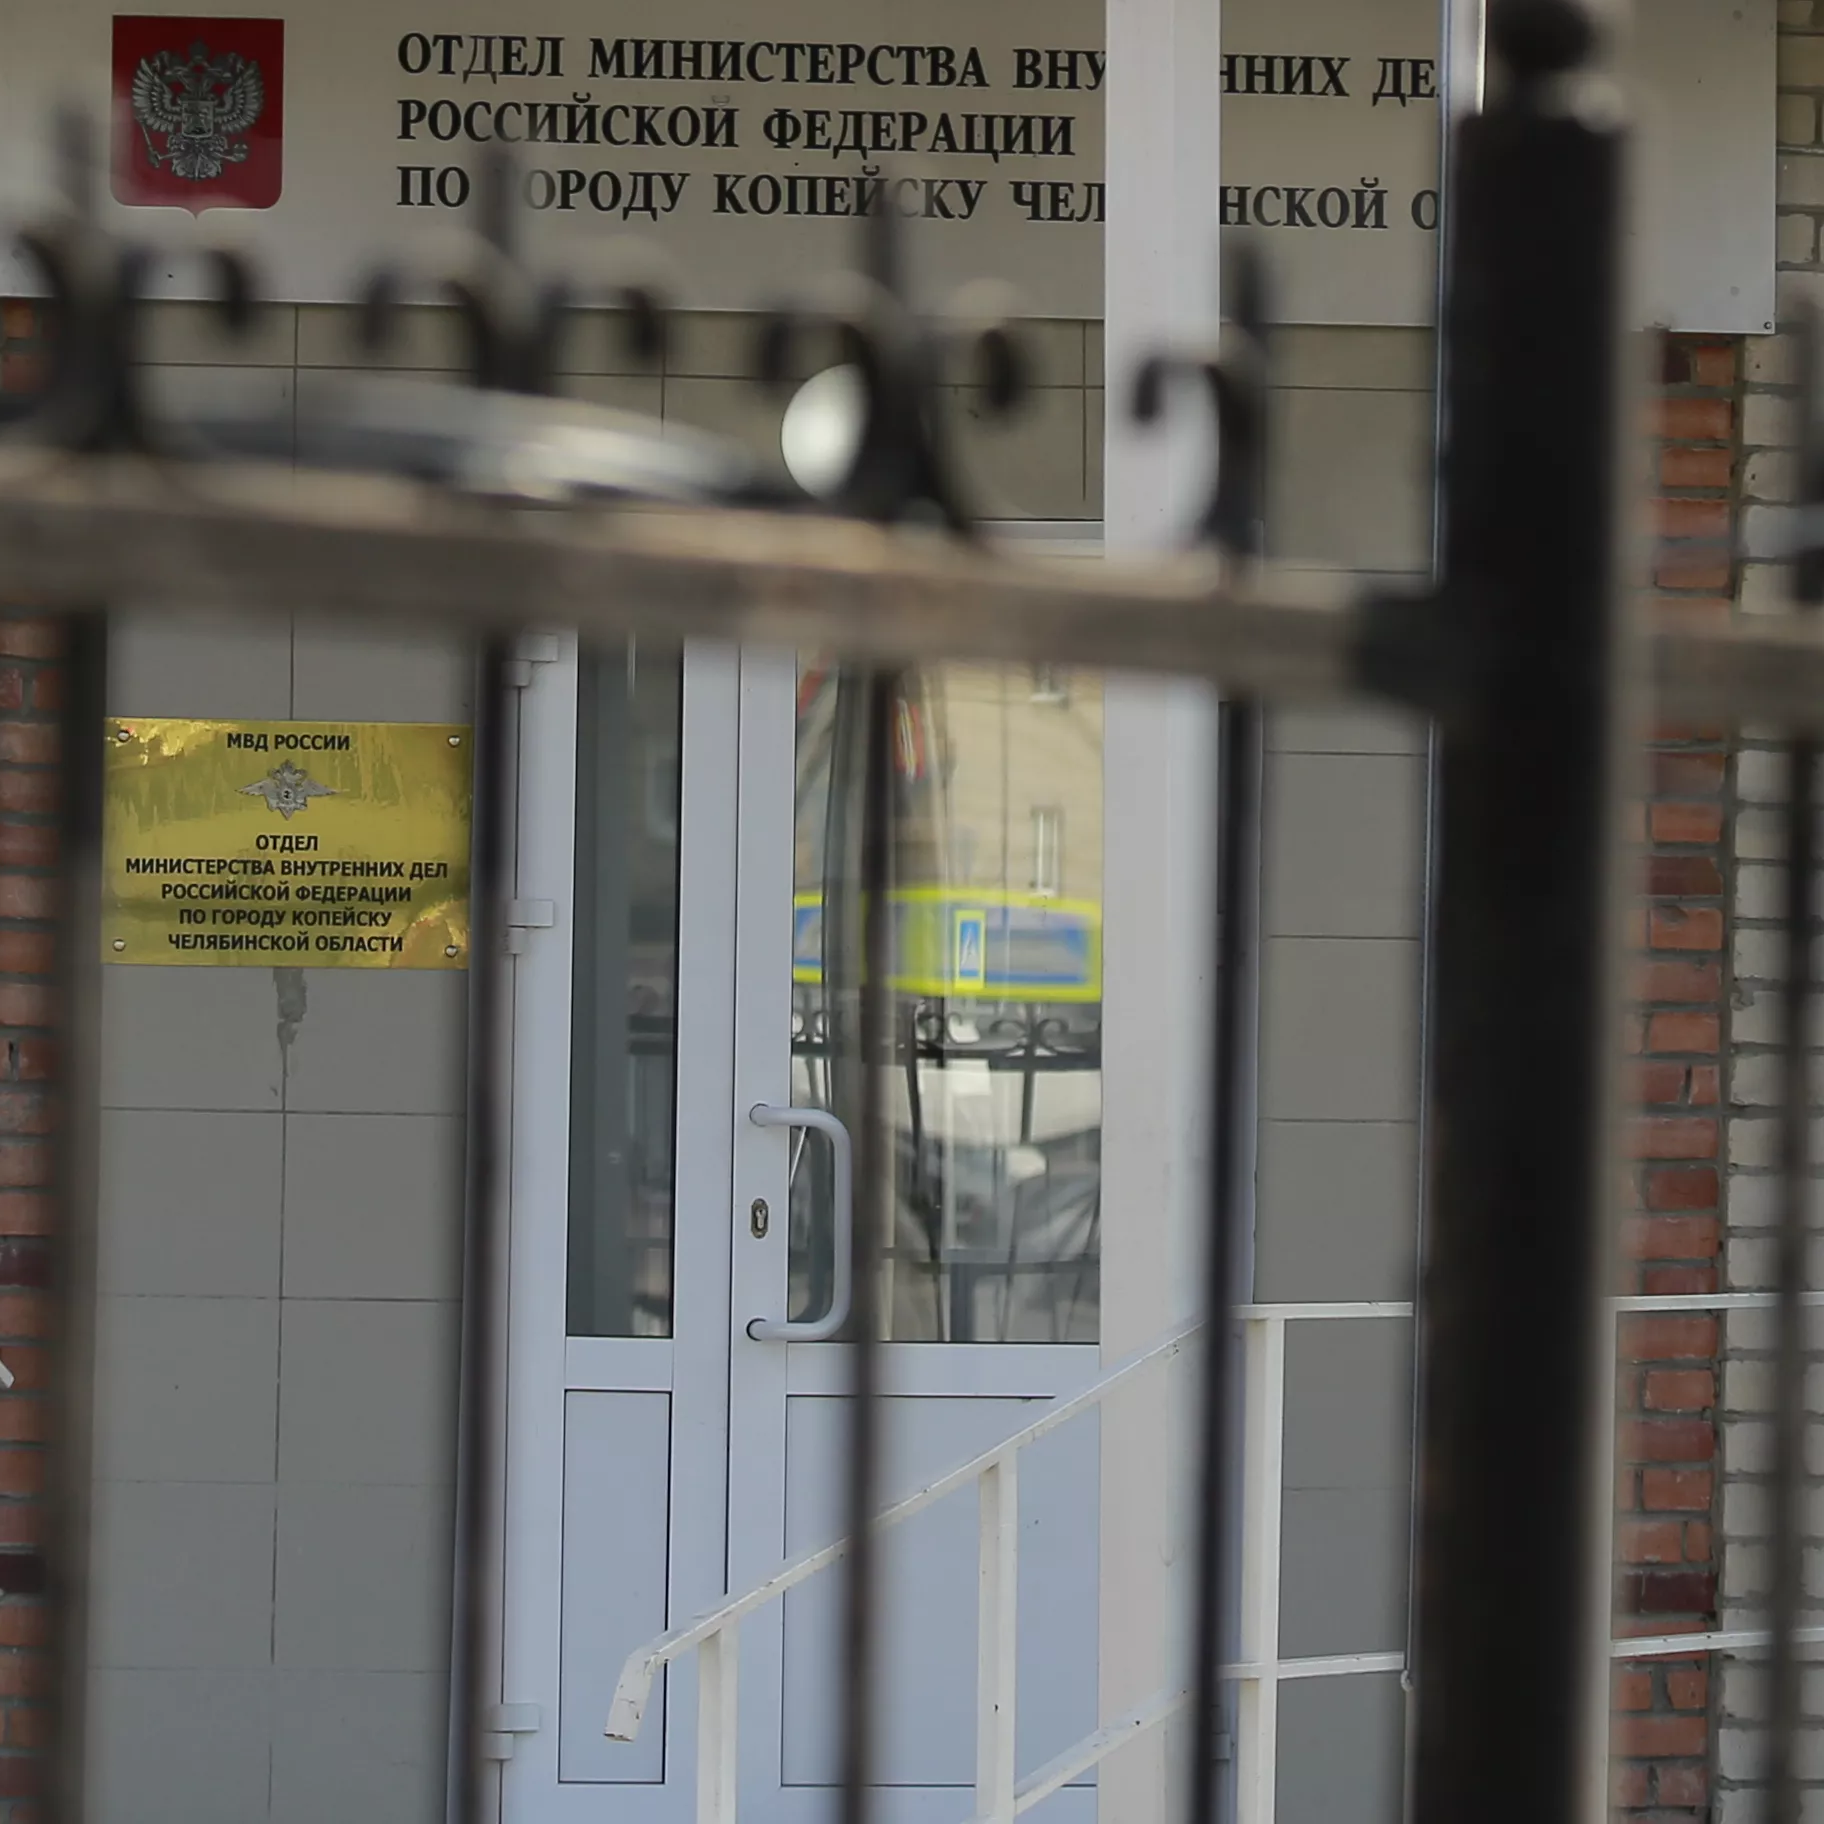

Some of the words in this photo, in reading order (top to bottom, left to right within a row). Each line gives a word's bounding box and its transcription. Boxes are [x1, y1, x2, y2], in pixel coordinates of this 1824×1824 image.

[398, 33, 564, 83] ОТДЕЛ
[588, 38, 989, 87] МИНИСТЕРСТВА
[1013, 48, 1350, 97] ВНУННИХ
[1372, 57, 1439, 107] ДЕ
[397, 92, 738, 148] РОССИЙСКОЙ
[763, 109, 1075, 163] ФЕДЕРАЦИИ
[397, 166, 470, 207] ПО
[488, 170, 690, 221] ОРОДУ
[713, 165, 987, 219] КОПЕЙСКУ
[1012, 177, 1388, 229] ЧЕЛНСКОЙ
[227, 732, 269, 753] МВД
[274, 733, 350, 751] РОССИИ
[255, 834, 319, 854] ОТДЕЛ
[125, 857, 276, 876] МИНИСТЕРСТВА
[280, 860, 405, 878] ВНУТРЕННИХ
[409, 862, 448, 881] ДЕЛ
[161, 879, 290, 902] РОССИЙСКОЙ
[295, 885, 412, 906] ФЕДЕРАЦИИ
[179, 908, 206, 925] ПО
[211, 908, 286, 929] ГОРОДУ
[291, 905, 392, 927] КОПЕЙСКУ
[168, 930, 310, 952] ЧЕЛЯБИНСКОЙ
[314, 935, 403, 952] ОБЛАСТИ
